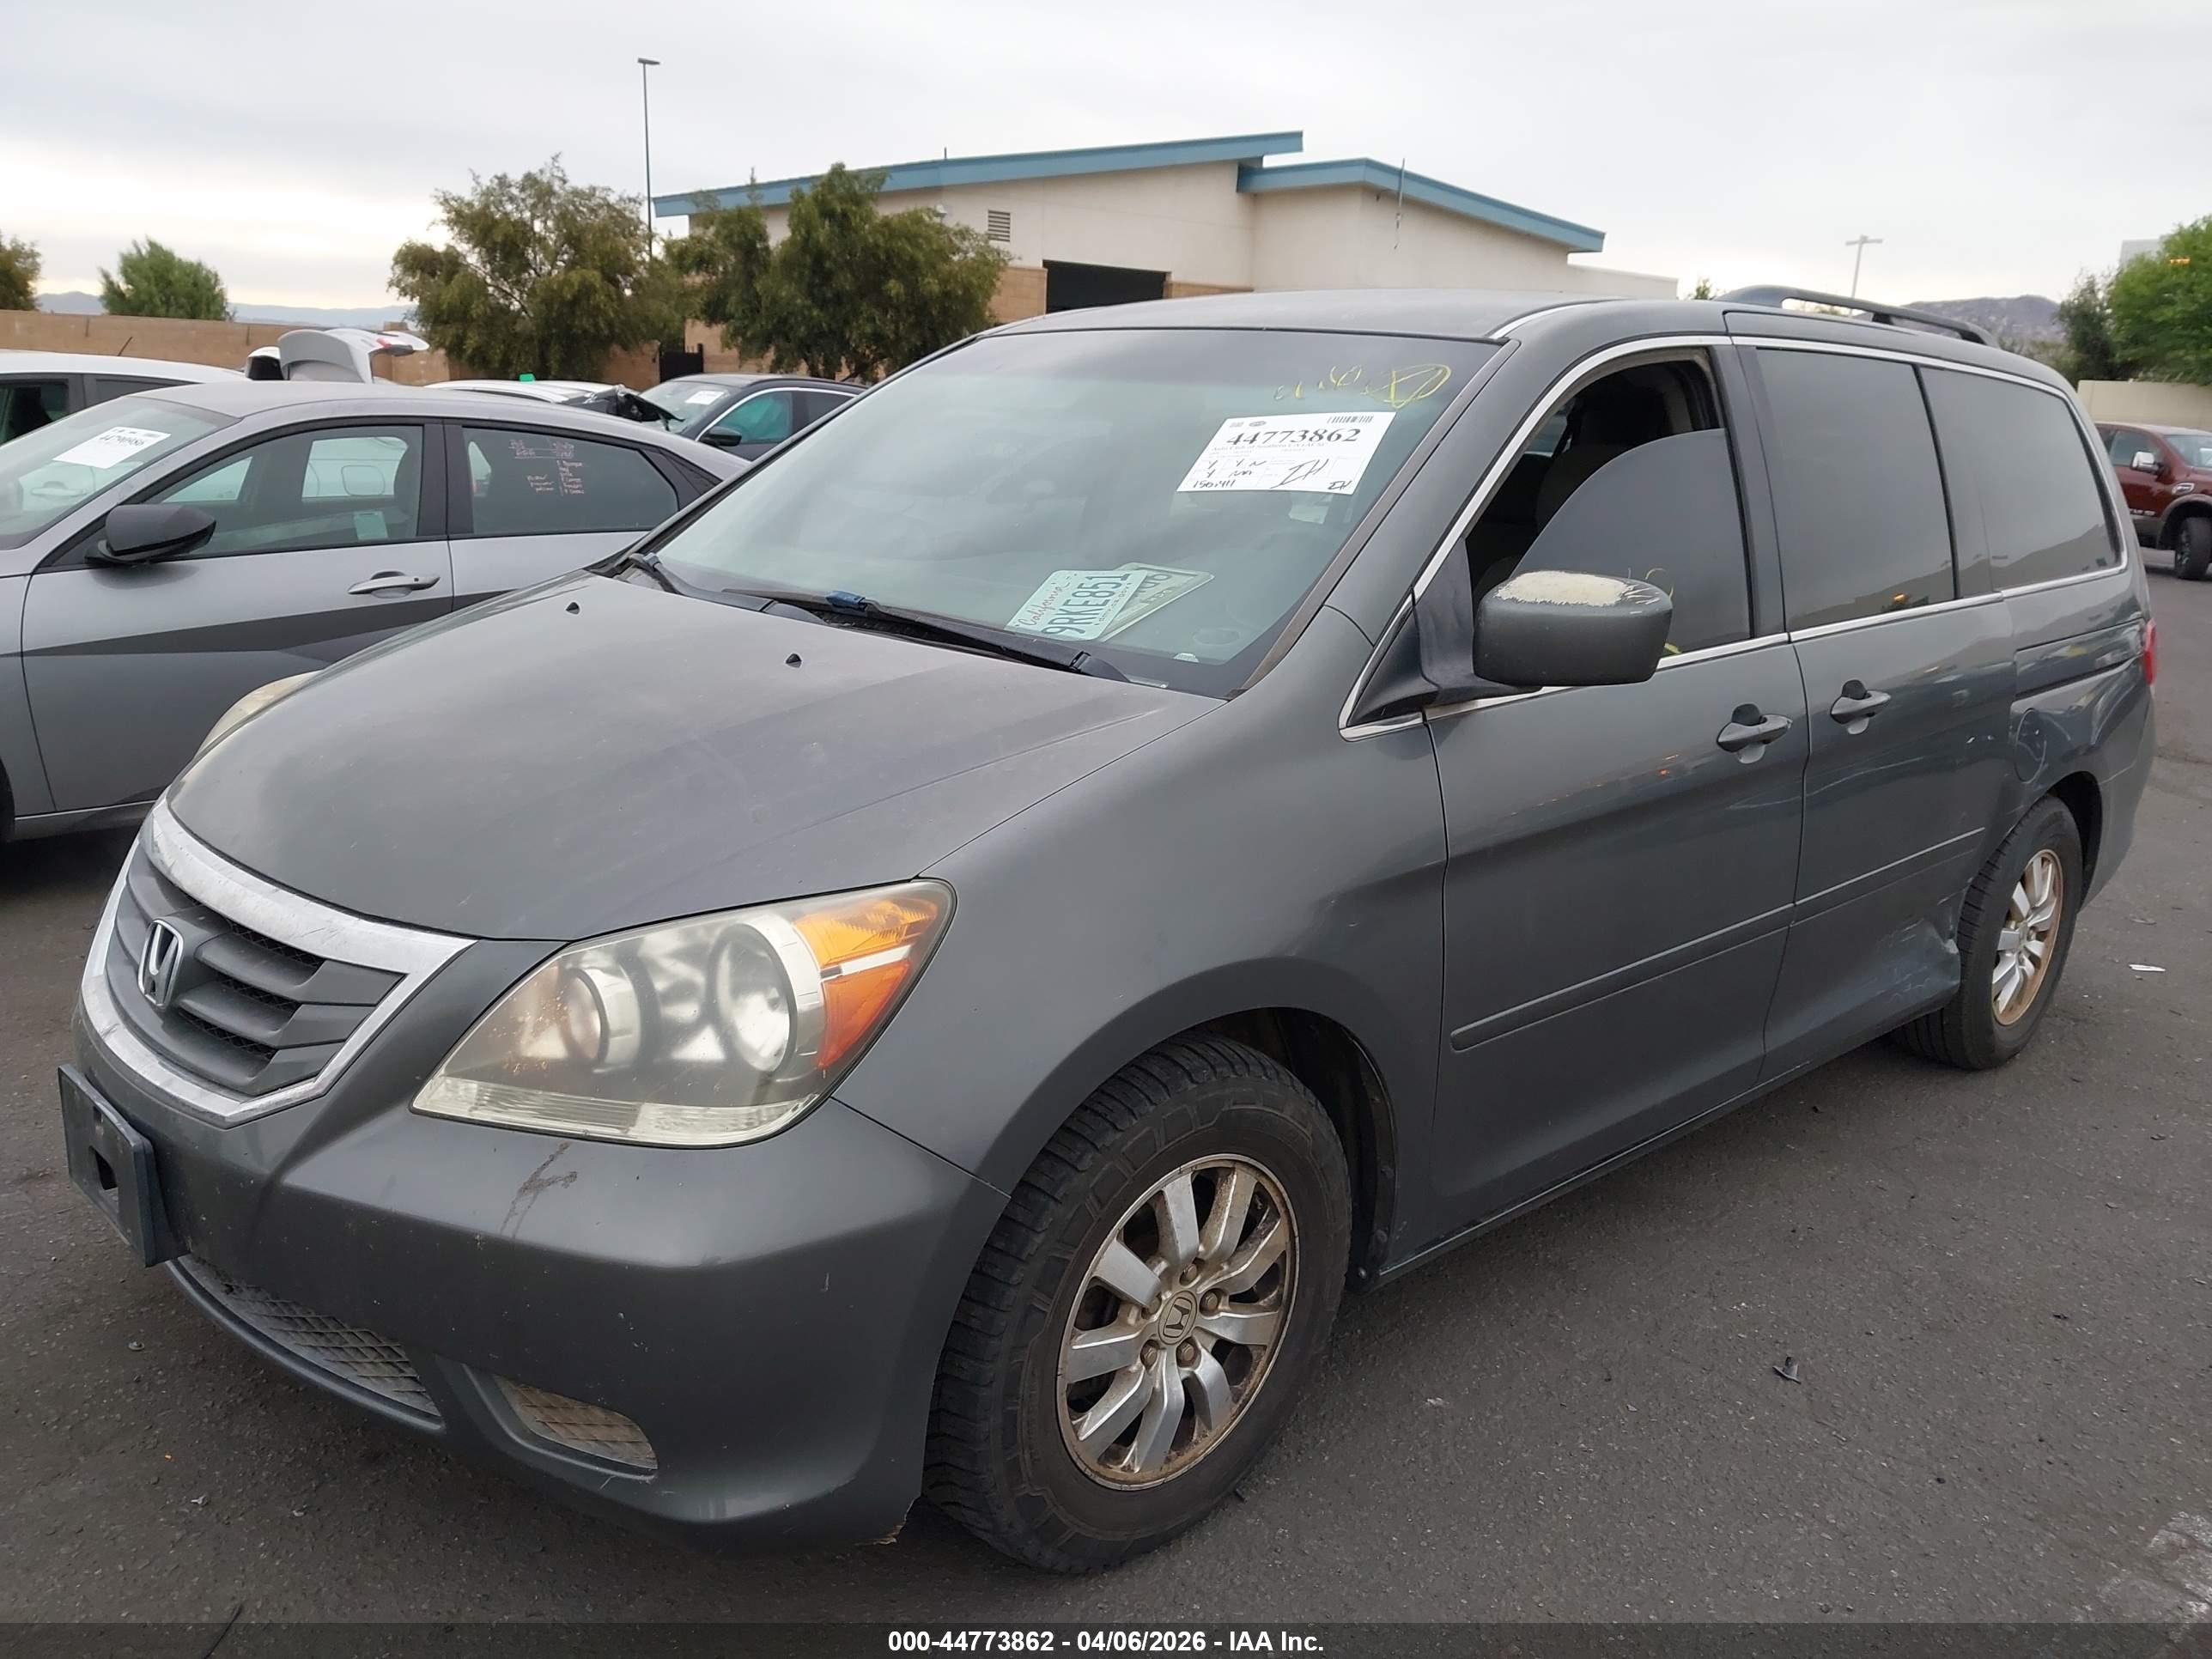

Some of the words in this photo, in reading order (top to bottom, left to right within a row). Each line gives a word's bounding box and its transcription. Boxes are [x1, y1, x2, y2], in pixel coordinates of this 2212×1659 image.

[1226, 428, 1361, 446] 44773862
[1018, 581, 1067, 626] California
[1041, 575, 1131, 635] 9RKE851
